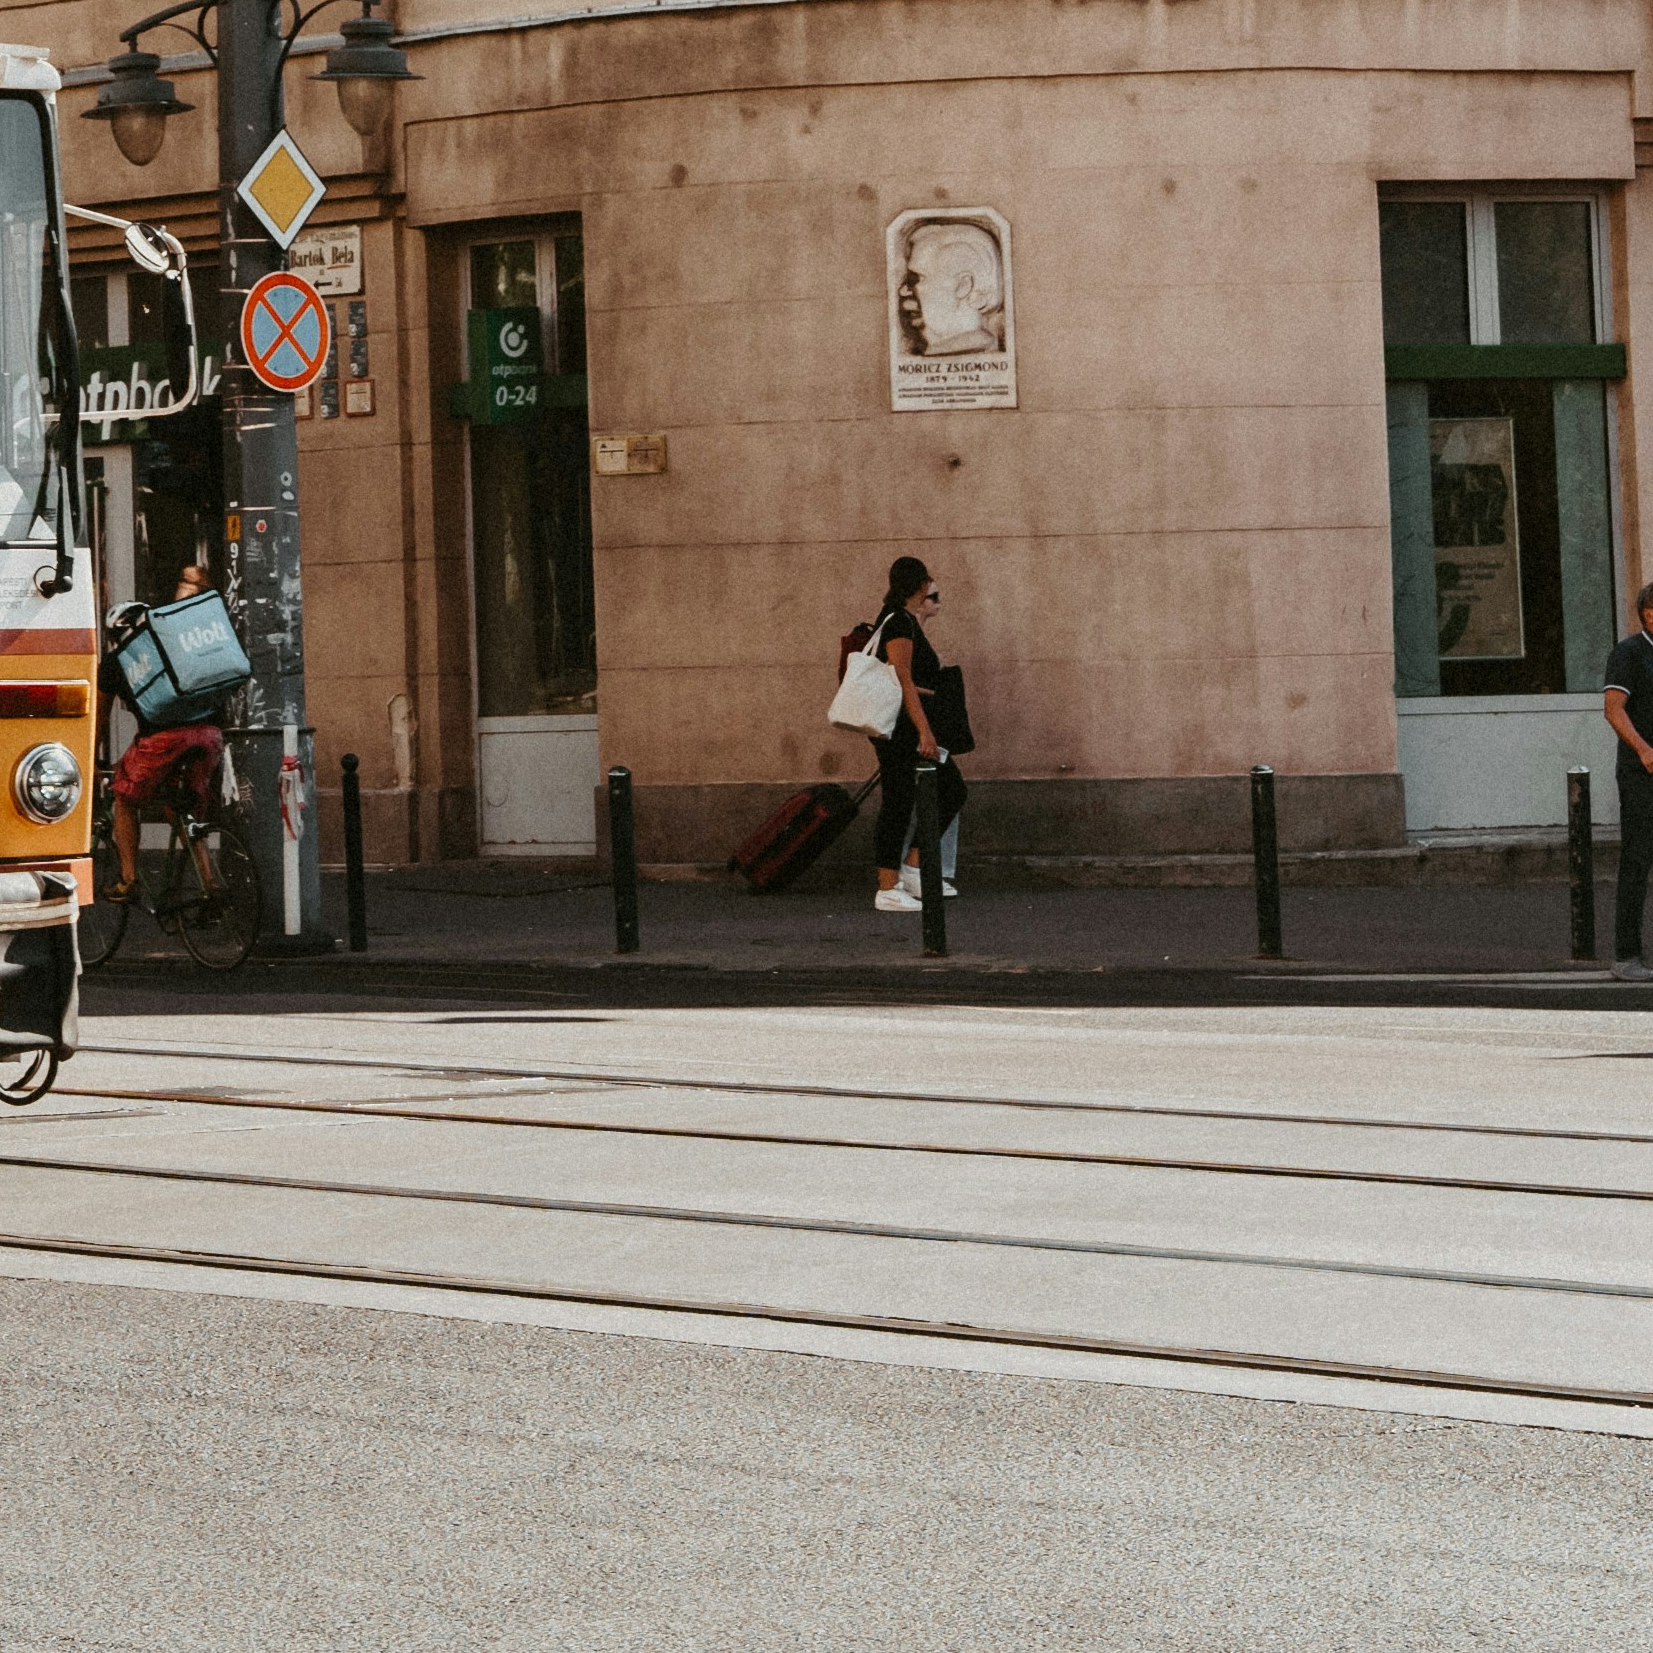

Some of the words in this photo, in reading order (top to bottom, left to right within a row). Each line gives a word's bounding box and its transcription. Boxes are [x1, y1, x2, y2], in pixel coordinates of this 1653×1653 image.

[946, 361, 1009, 373] ZSIGMOND
[496, 385, 538, 406] 0-24
[177, 621, 229, 653] Wolt
